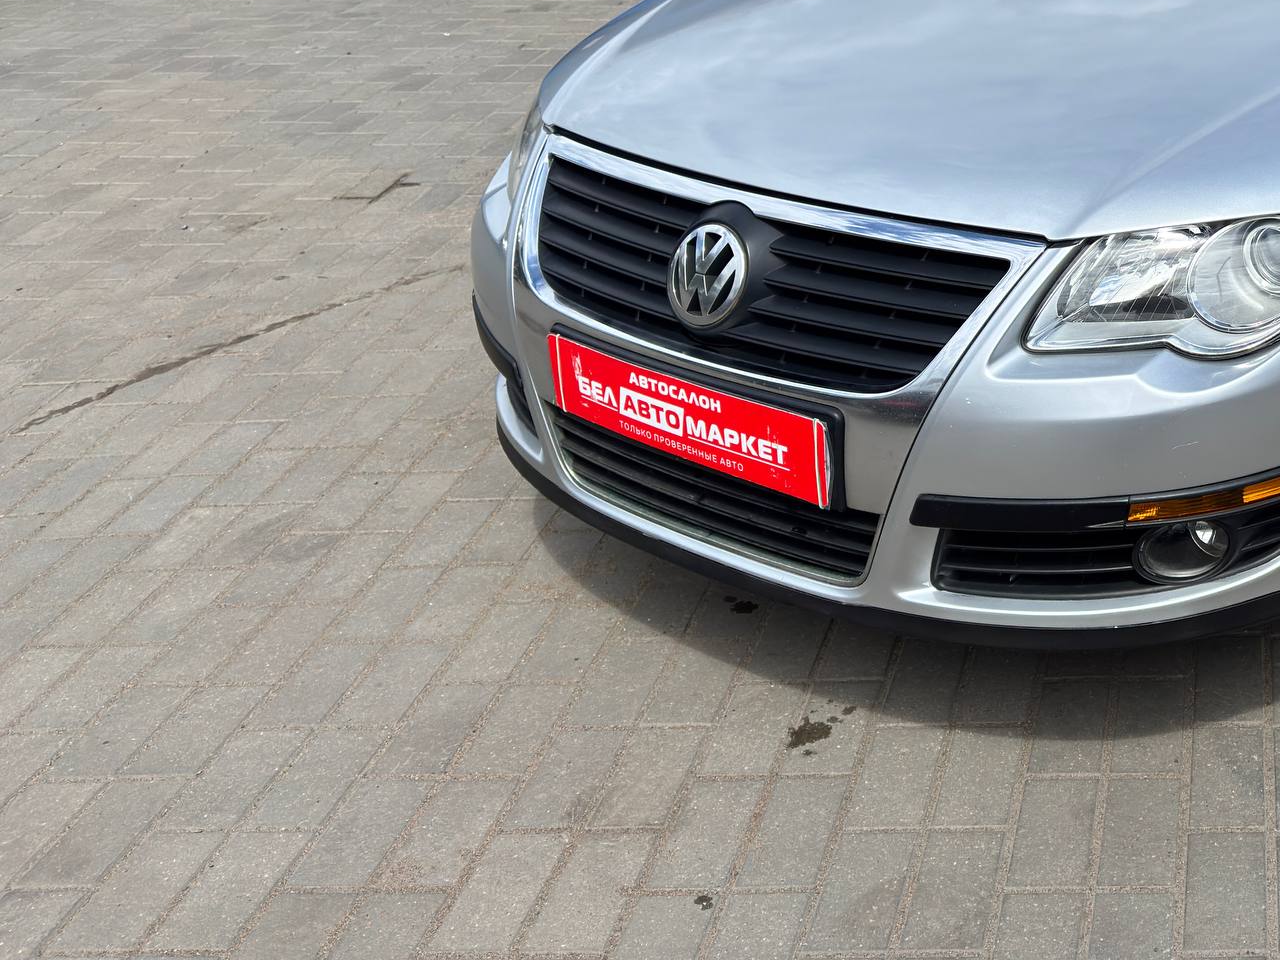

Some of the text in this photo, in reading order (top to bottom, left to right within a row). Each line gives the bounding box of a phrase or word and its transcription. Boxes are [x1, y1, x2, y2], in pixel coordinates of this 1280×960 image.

[628, 371, 721, 413] АВТОСАЛОН
[577, 376, 788, 465] БЕЛ АВТО МАРКЕТ
[619, 419, 744, 472] ТОЛЬКО ПРОВЕРЕННЫЕ АВТО
